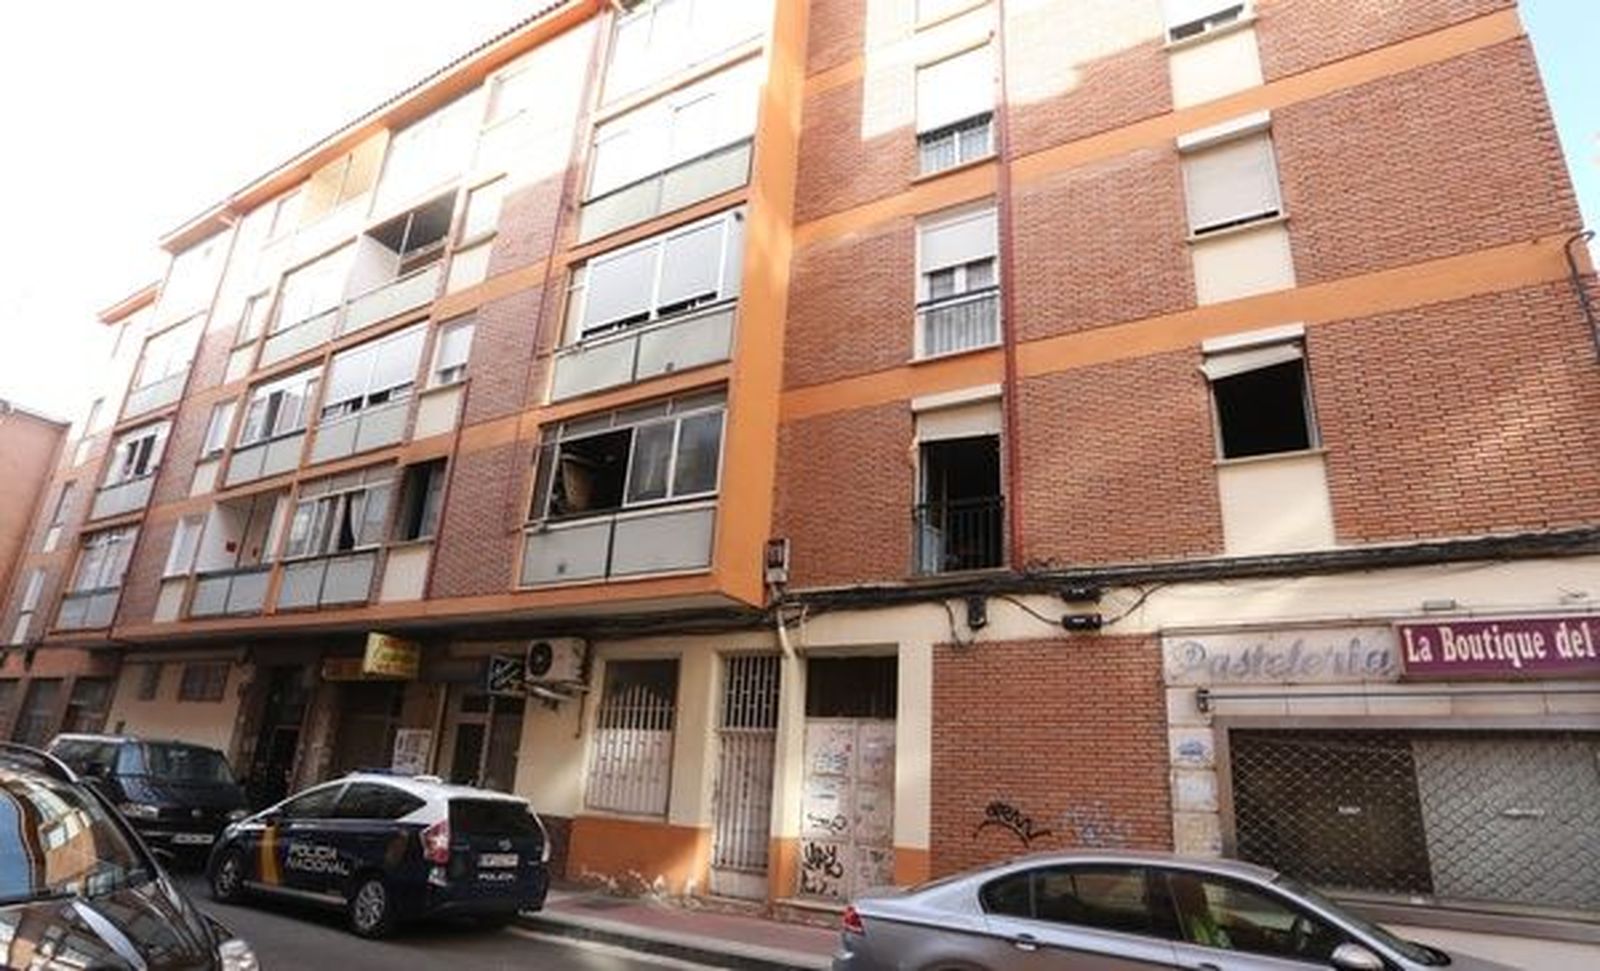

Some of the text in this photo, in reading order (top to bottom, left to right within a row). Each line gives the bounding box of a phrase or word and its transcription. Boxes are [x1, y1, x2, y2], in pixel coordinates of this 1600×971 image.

[1405, 620, 1592, 668] La Boutique del
[285, 856, 350, 876] NACIONAL
